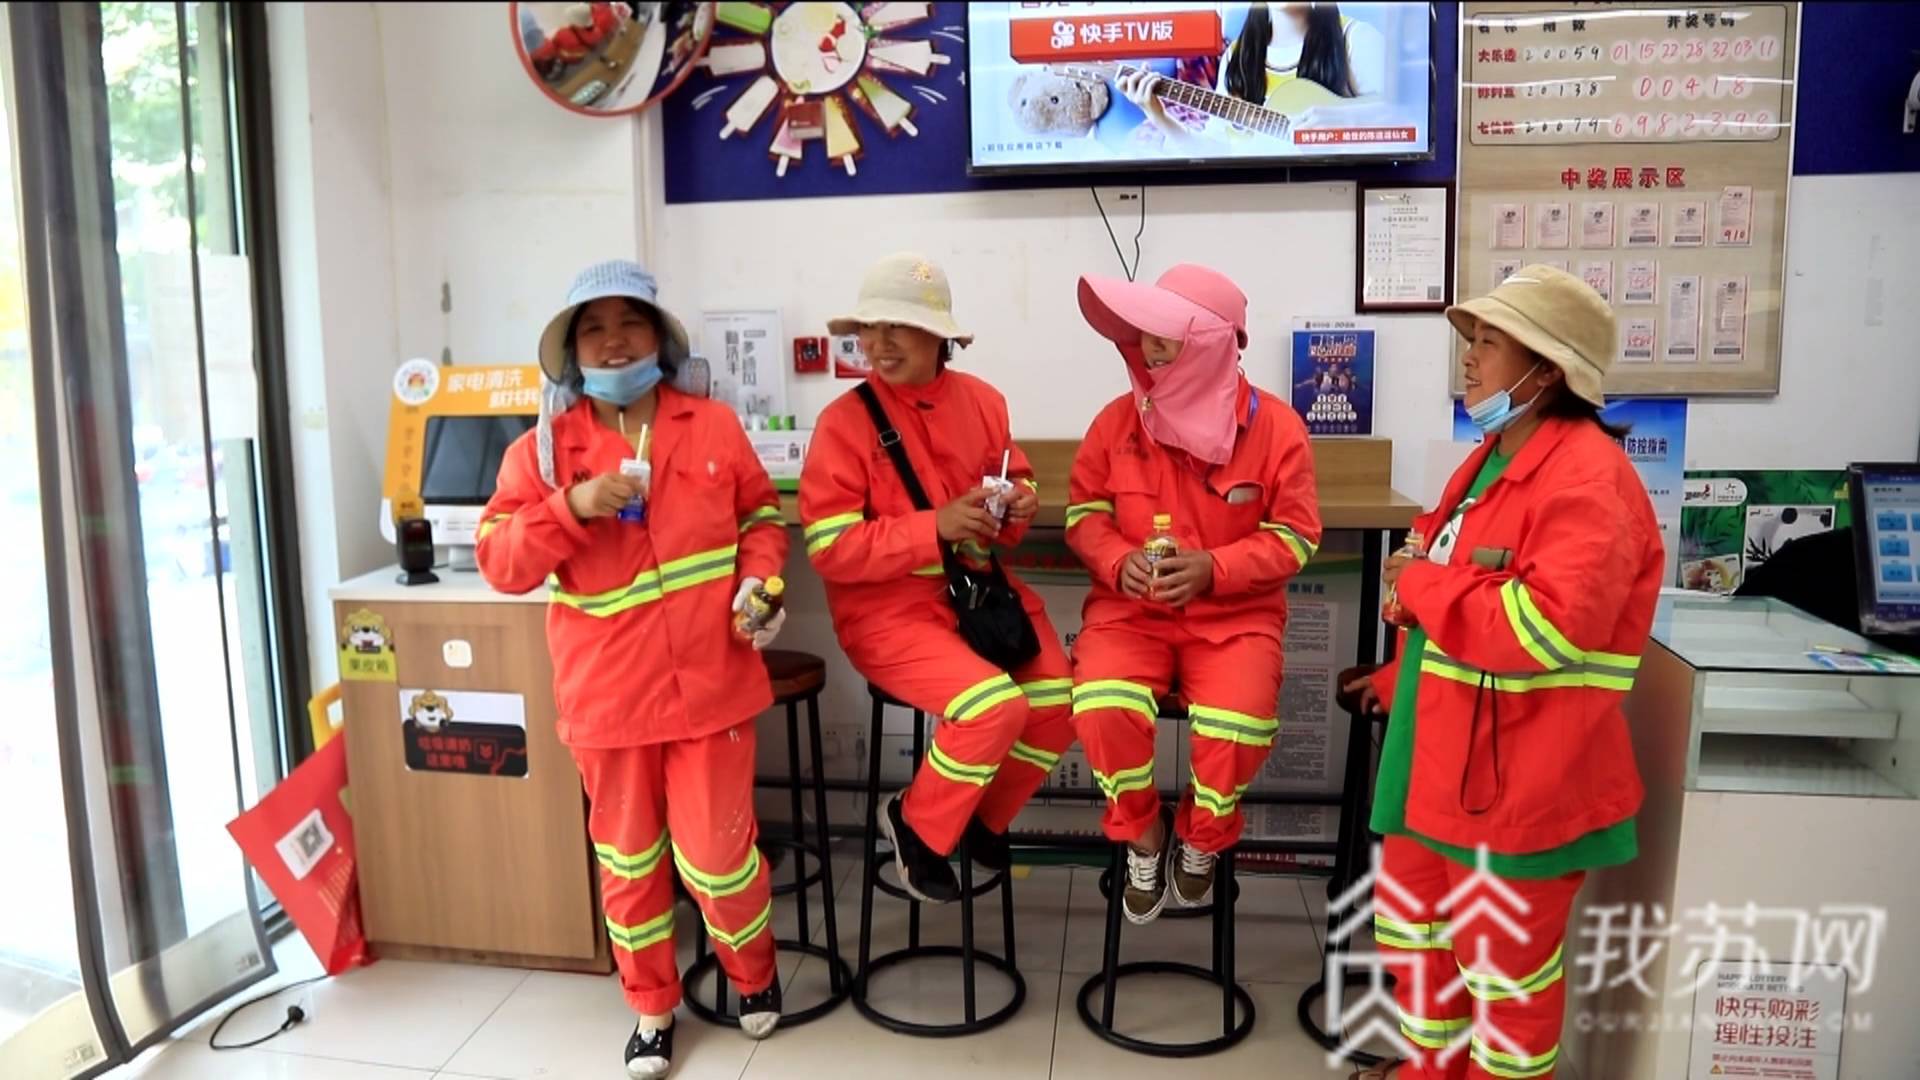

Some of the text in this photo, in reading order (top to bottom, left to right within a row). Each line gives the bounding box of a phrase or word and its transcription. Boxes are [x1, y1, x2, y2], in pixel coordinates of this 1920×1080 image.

[1080, 20, 1173, 44] 快手TV版
[1478, 48, 1517, 63] 大乐透
[1561, 167, 1686, 190] 中奖展示区
[1715, 996, 1821, 1022] 快乐购彩
[1713, 1022, 1817, 1049] 理性投注
